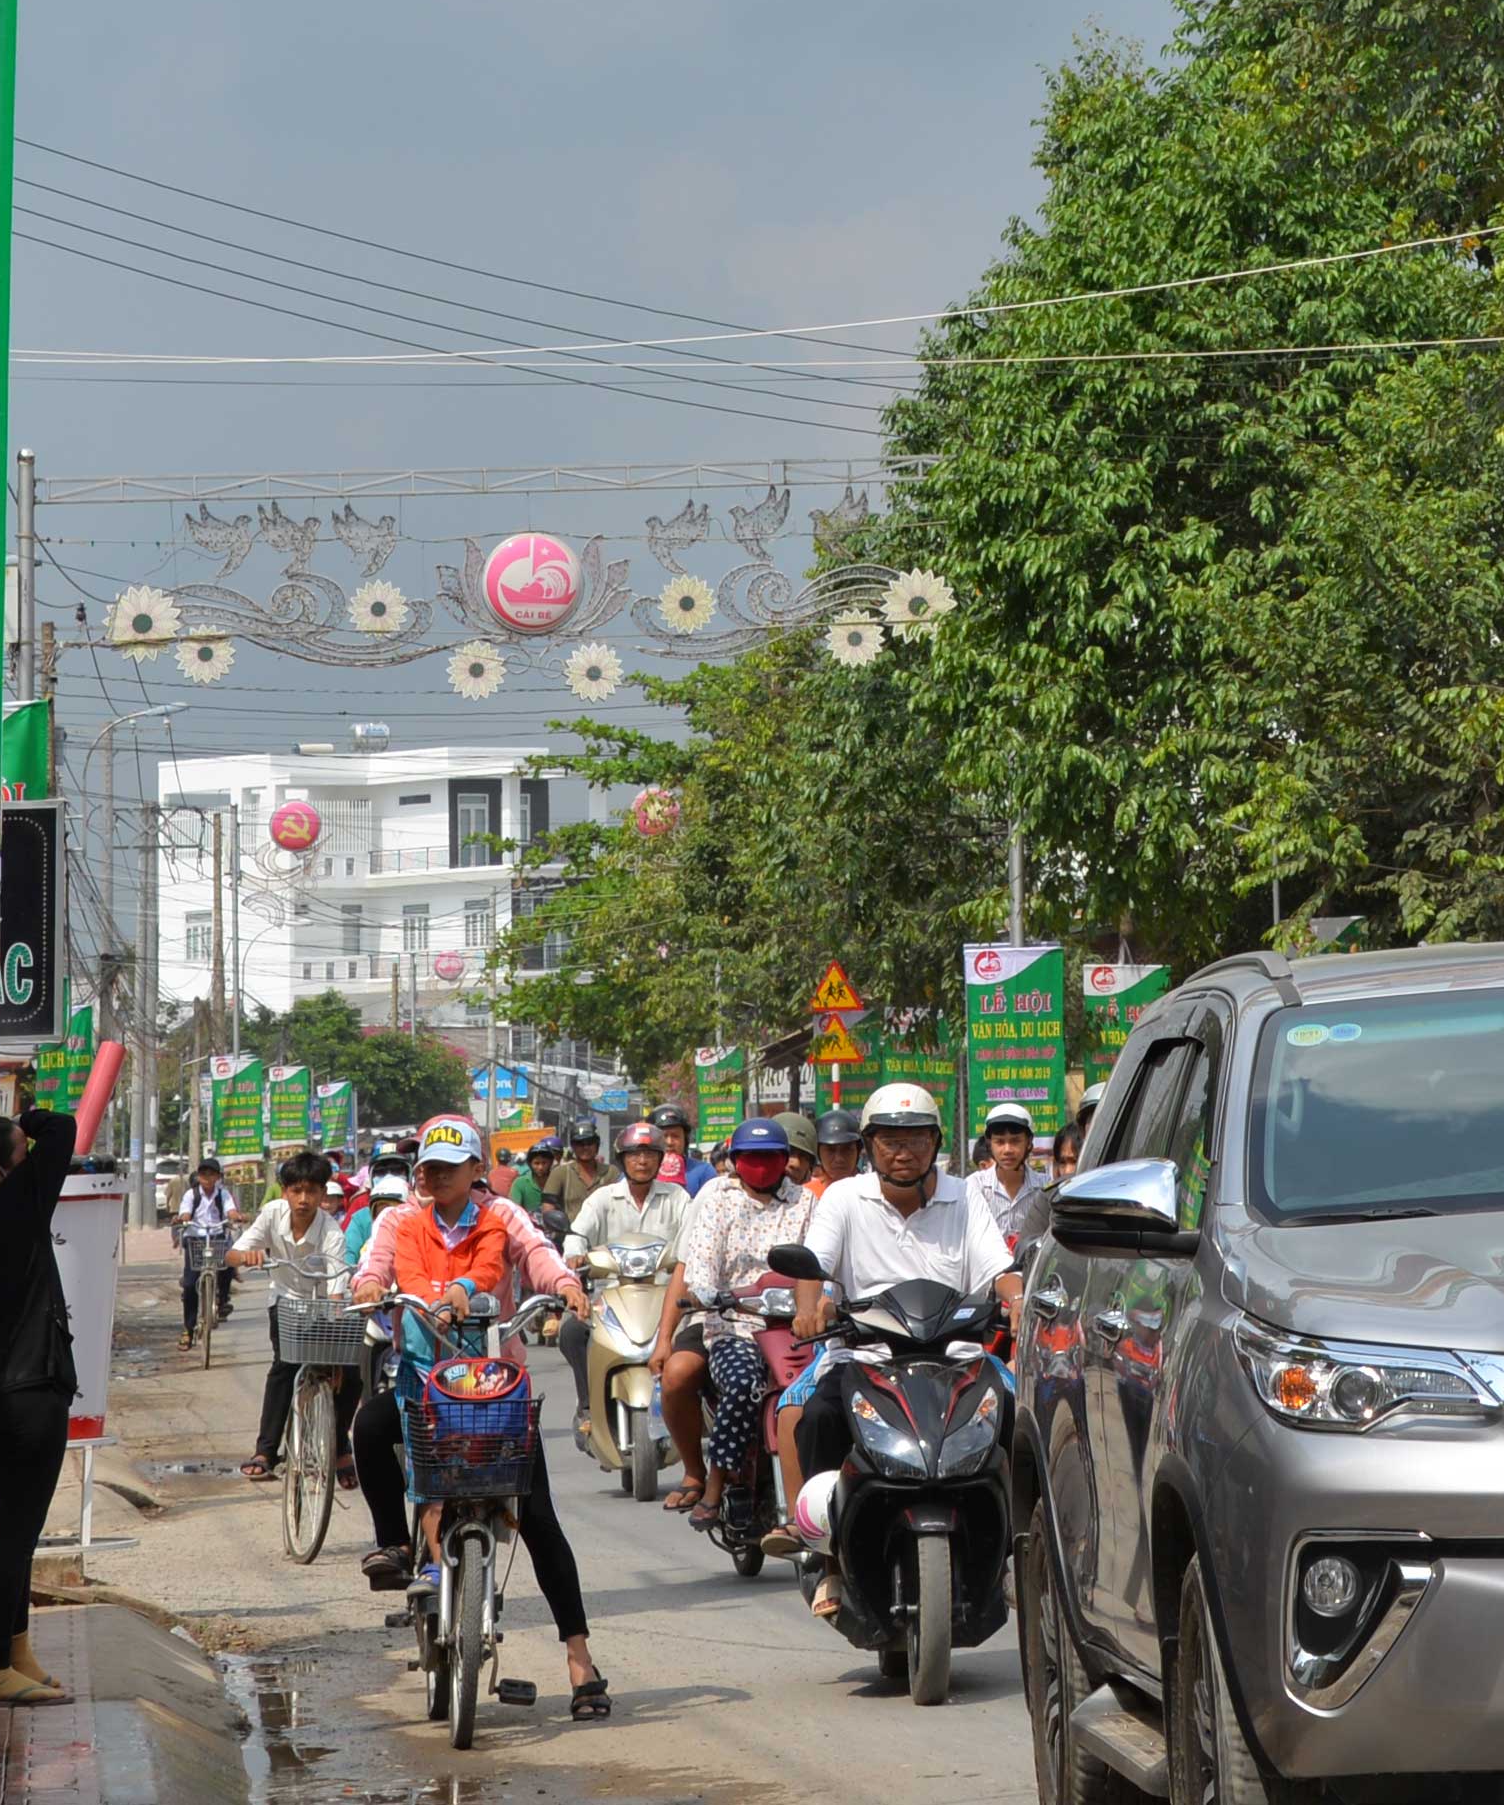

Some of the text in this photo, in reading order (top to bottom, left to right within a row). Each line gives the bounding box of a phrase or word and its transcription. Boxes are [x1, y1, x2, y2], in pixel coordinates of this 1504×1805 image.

[980, 987, 1051, 1016] LỄ HỘI
[972, 1021, 1060, 1040] VĂN DU LỊCH
